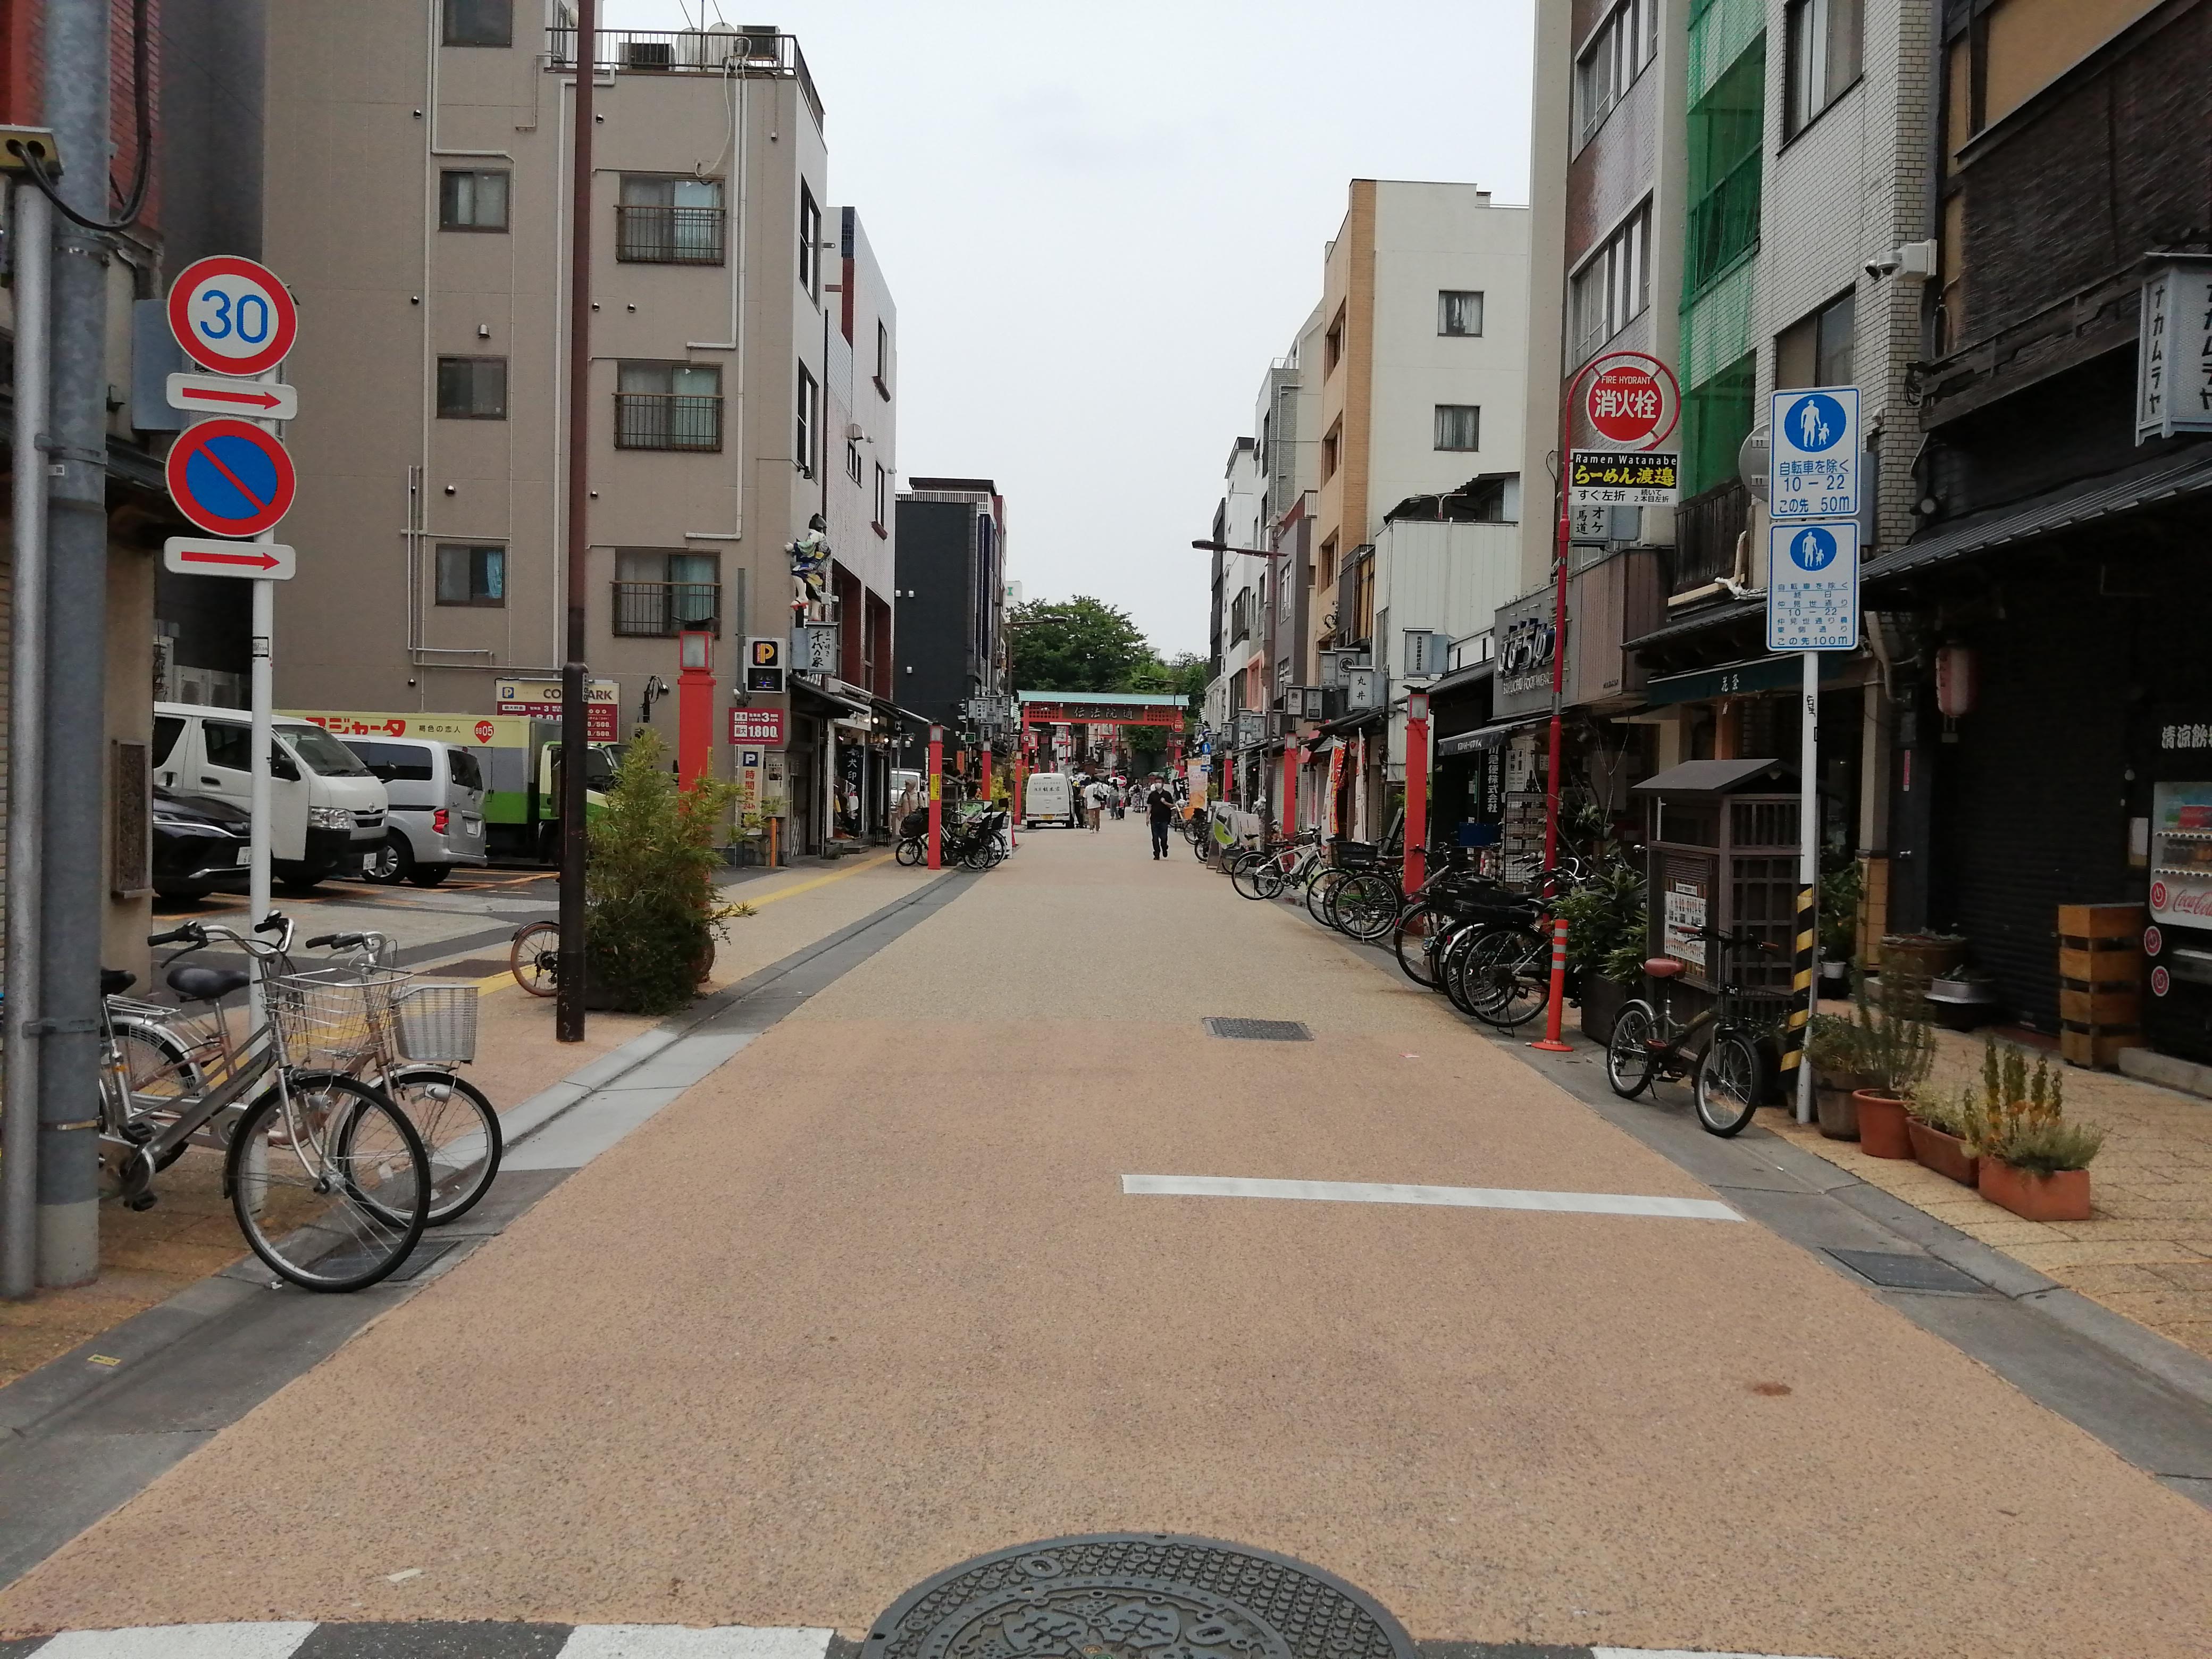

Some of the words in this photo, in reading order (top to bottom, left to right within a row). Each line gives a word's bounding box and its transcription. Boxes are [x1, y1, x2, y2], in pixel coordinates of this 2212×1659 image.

[200, 290, 267, 343] 30
[2149, 284, 2165, 414] ナカムラヤ
[1601, 375, 1617, 384] FIRE
[1619, 376, 1652, 384] HYDRANT
[1595, 389, 1657, 418] 消火栓
[1576, 454, 1613, 464] Ramen
[1619, 455, 1677, 465] Watanabe
[1780, 459, 1849, 476] 自転車を除く
[1784, 476, 1801, 492] 10
[1826, 474, 1845, 490] 22
[1578, 489, 1626, 501] すぐ左折
[1779, 498, 1809, 513] この先
[1821, 496, 1849, 512] 50m
[1577, 505, 1588, 535] 馬道
[588, 690, 613, 700] ARK
[1356, 676, 1366, 701] 丸井
[1074, 707, 1133, 719] 伝法院通
